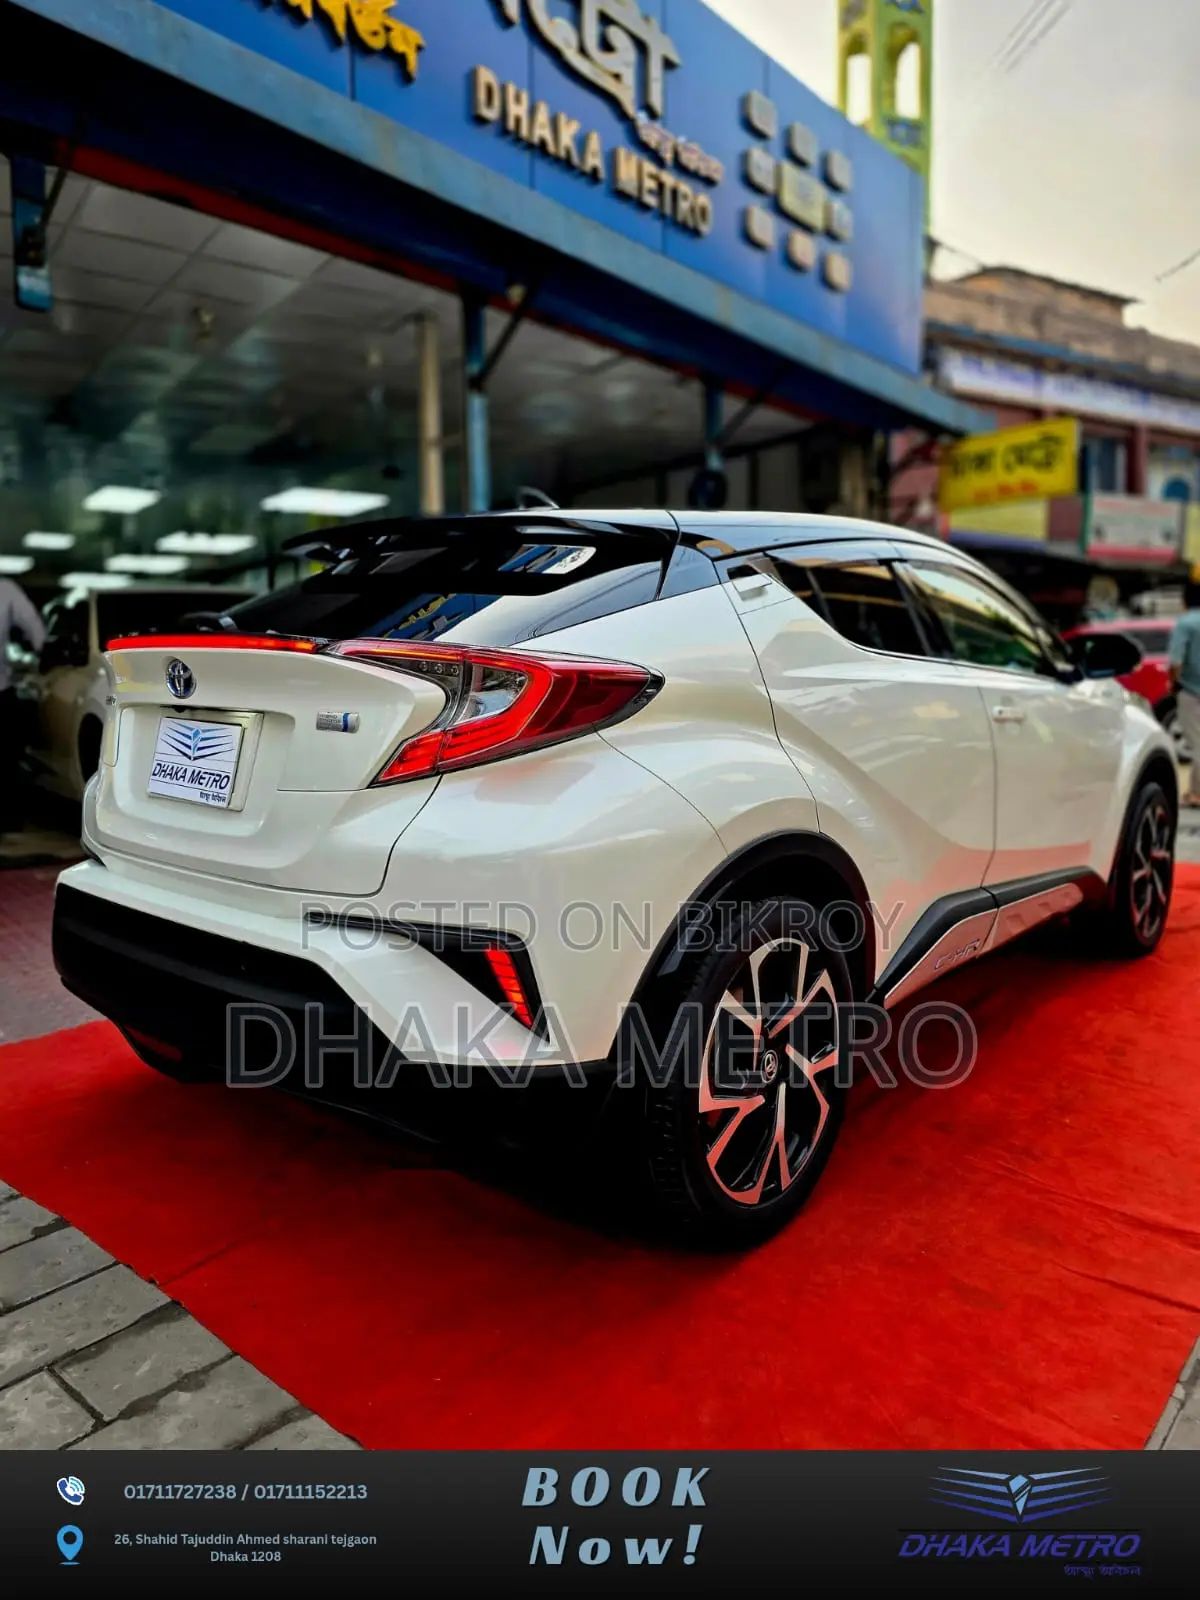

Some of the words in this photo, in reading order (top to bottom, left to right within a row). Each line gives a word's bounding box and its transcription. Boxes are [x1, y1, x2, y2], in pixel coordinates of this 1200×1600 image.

[473, 64, 603, 180] DHAKA
[613, 146, 712, 237] METRO
[152, 762, 188, 782] DHAKA
[187, 768, 231, 790] METRO
